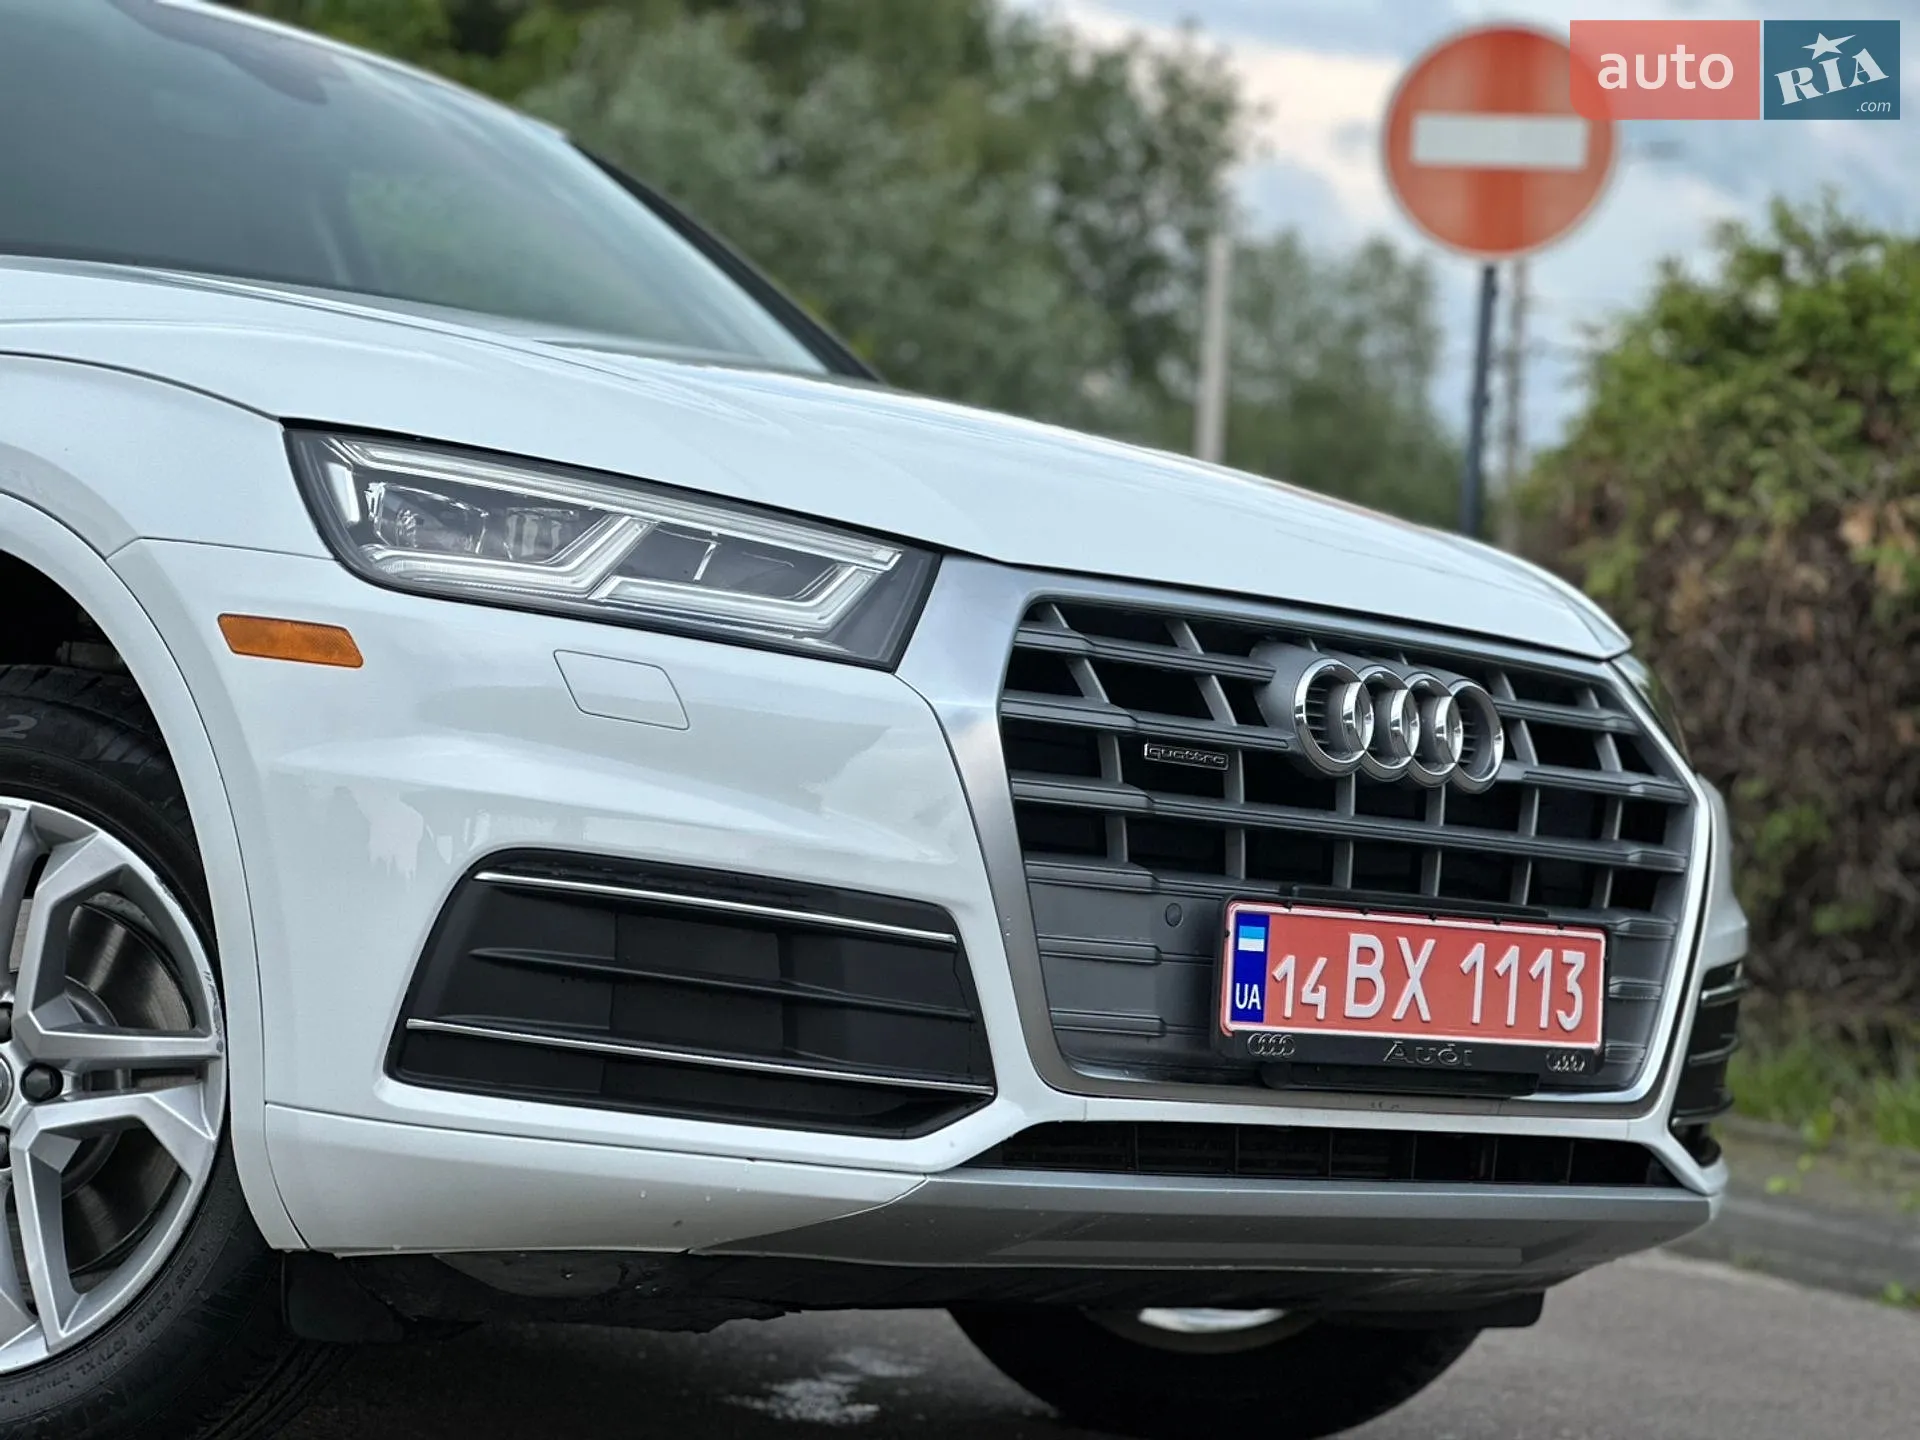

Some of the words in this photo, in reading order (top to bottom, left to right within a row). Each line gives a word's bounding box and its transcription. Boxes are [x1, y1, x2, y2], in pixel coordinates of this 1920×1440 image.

[1149, 747, 1226, 765] quattro
[1272, 954, 1327, 1020] 14
[1344, 932, 1437, 1022] BX
[1460, 942, 1586, 1031] 1113
[1235, 982, 1262, 1011] UA
